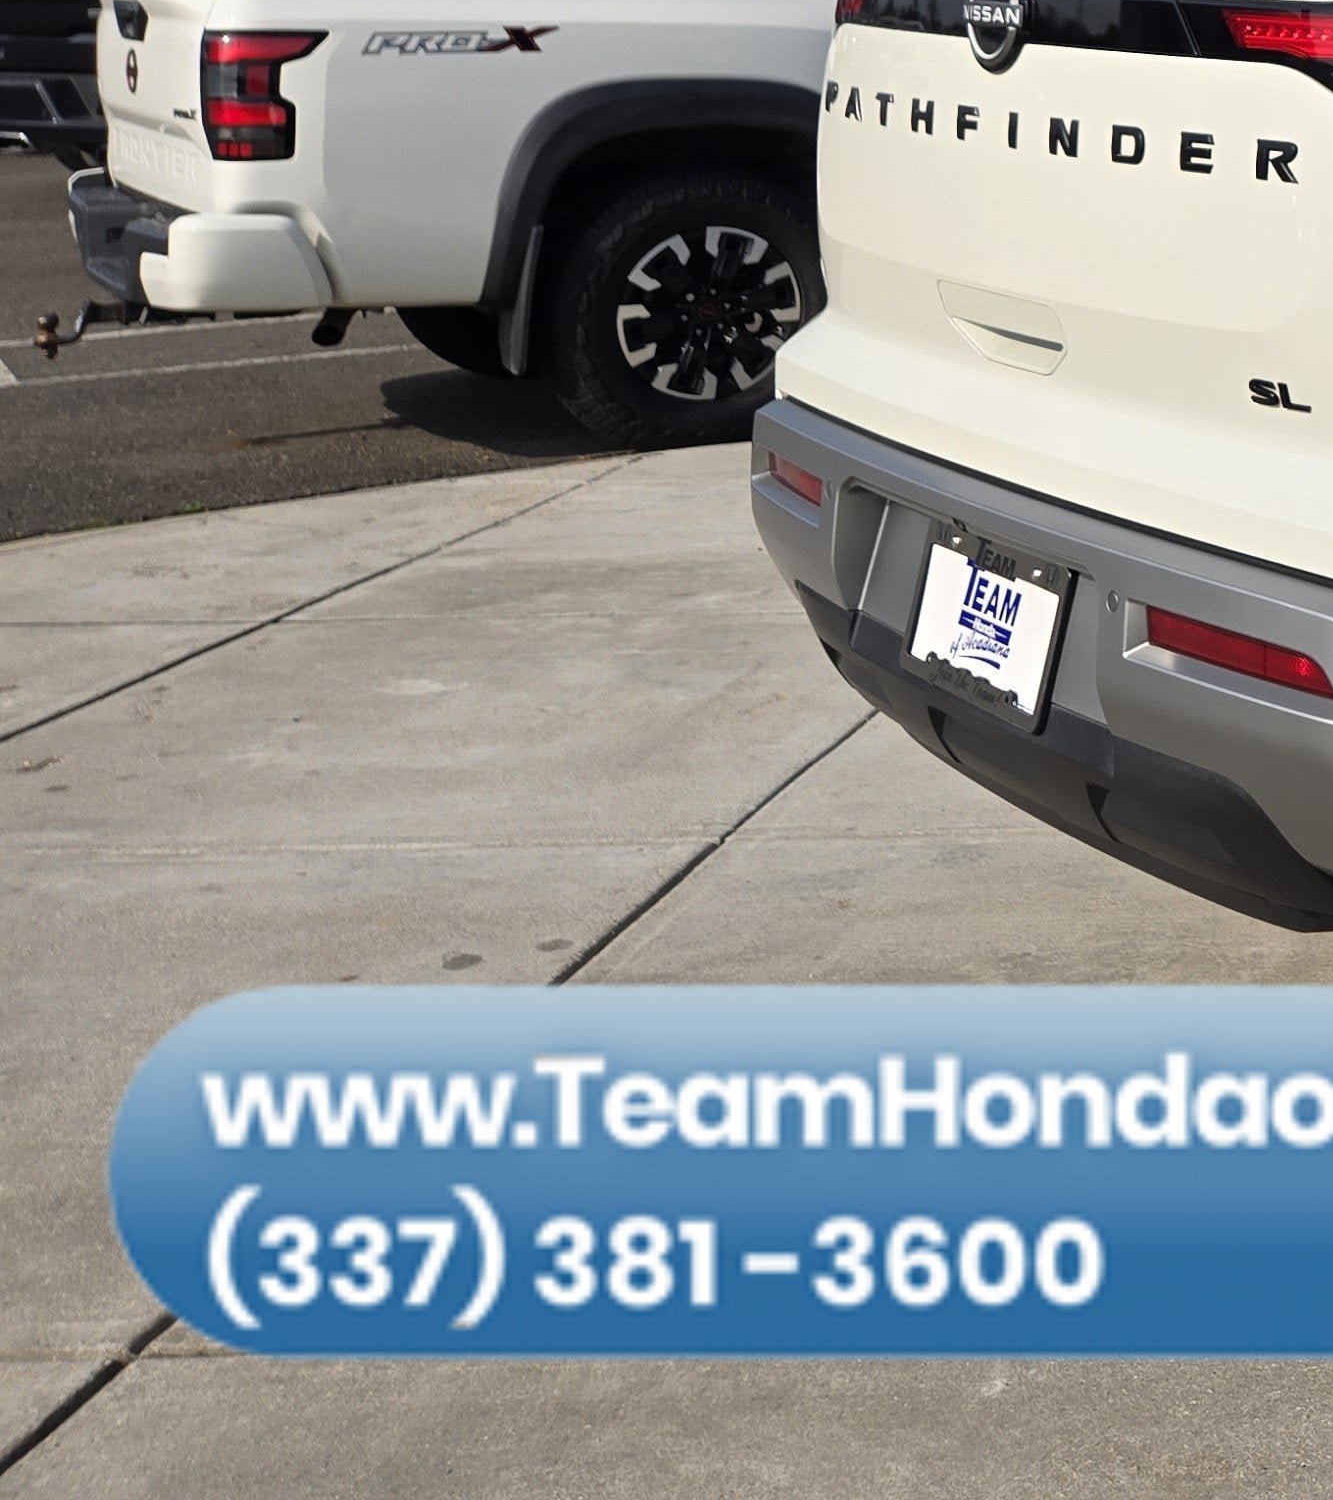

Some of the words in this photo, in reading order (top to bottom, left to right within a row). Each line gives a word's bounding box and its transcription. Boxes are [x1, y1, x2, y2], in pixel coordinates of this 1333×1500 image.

[963, 3, 1021, 25] NISSAN
[824, 80, 1300, 184] PATHFINDER
[1247, 378, 1313, 413] SL
